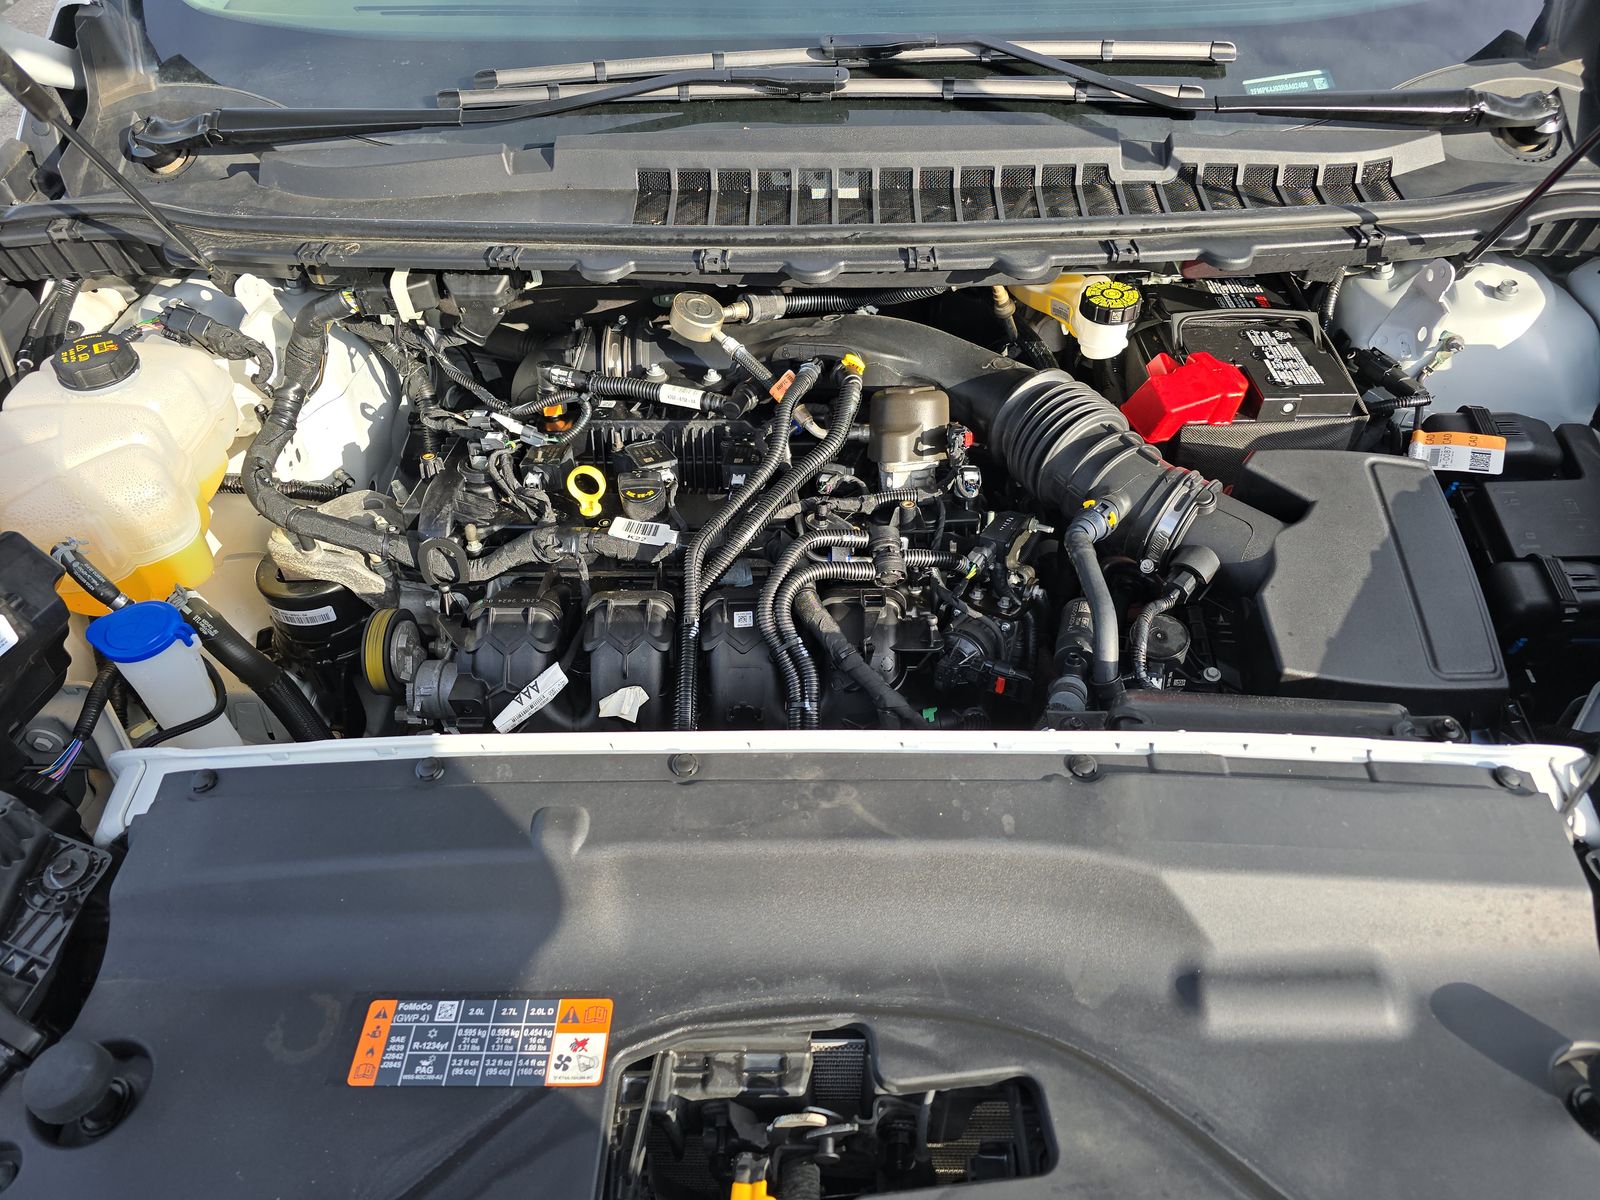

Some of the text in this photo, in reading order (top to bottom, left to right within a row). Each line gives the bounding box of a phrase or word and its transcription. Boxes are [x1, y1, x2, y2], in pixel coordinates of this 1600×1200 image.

[1425, 434, 1436, 445] CAD
[1442, 434, 1452, 444] CAD
[1469, 436, 1478, 447] CAD
[514, 680, 540, 706] AAA
[398, 1002, 432, 1010] FoMoCo
[393, 1014, 430, 1024] (GWP 4)
[478, 1028, 486, 1038] kg
[511, 1028, 520, 1038] kg
[544, 1028, 552, 1038] kg
